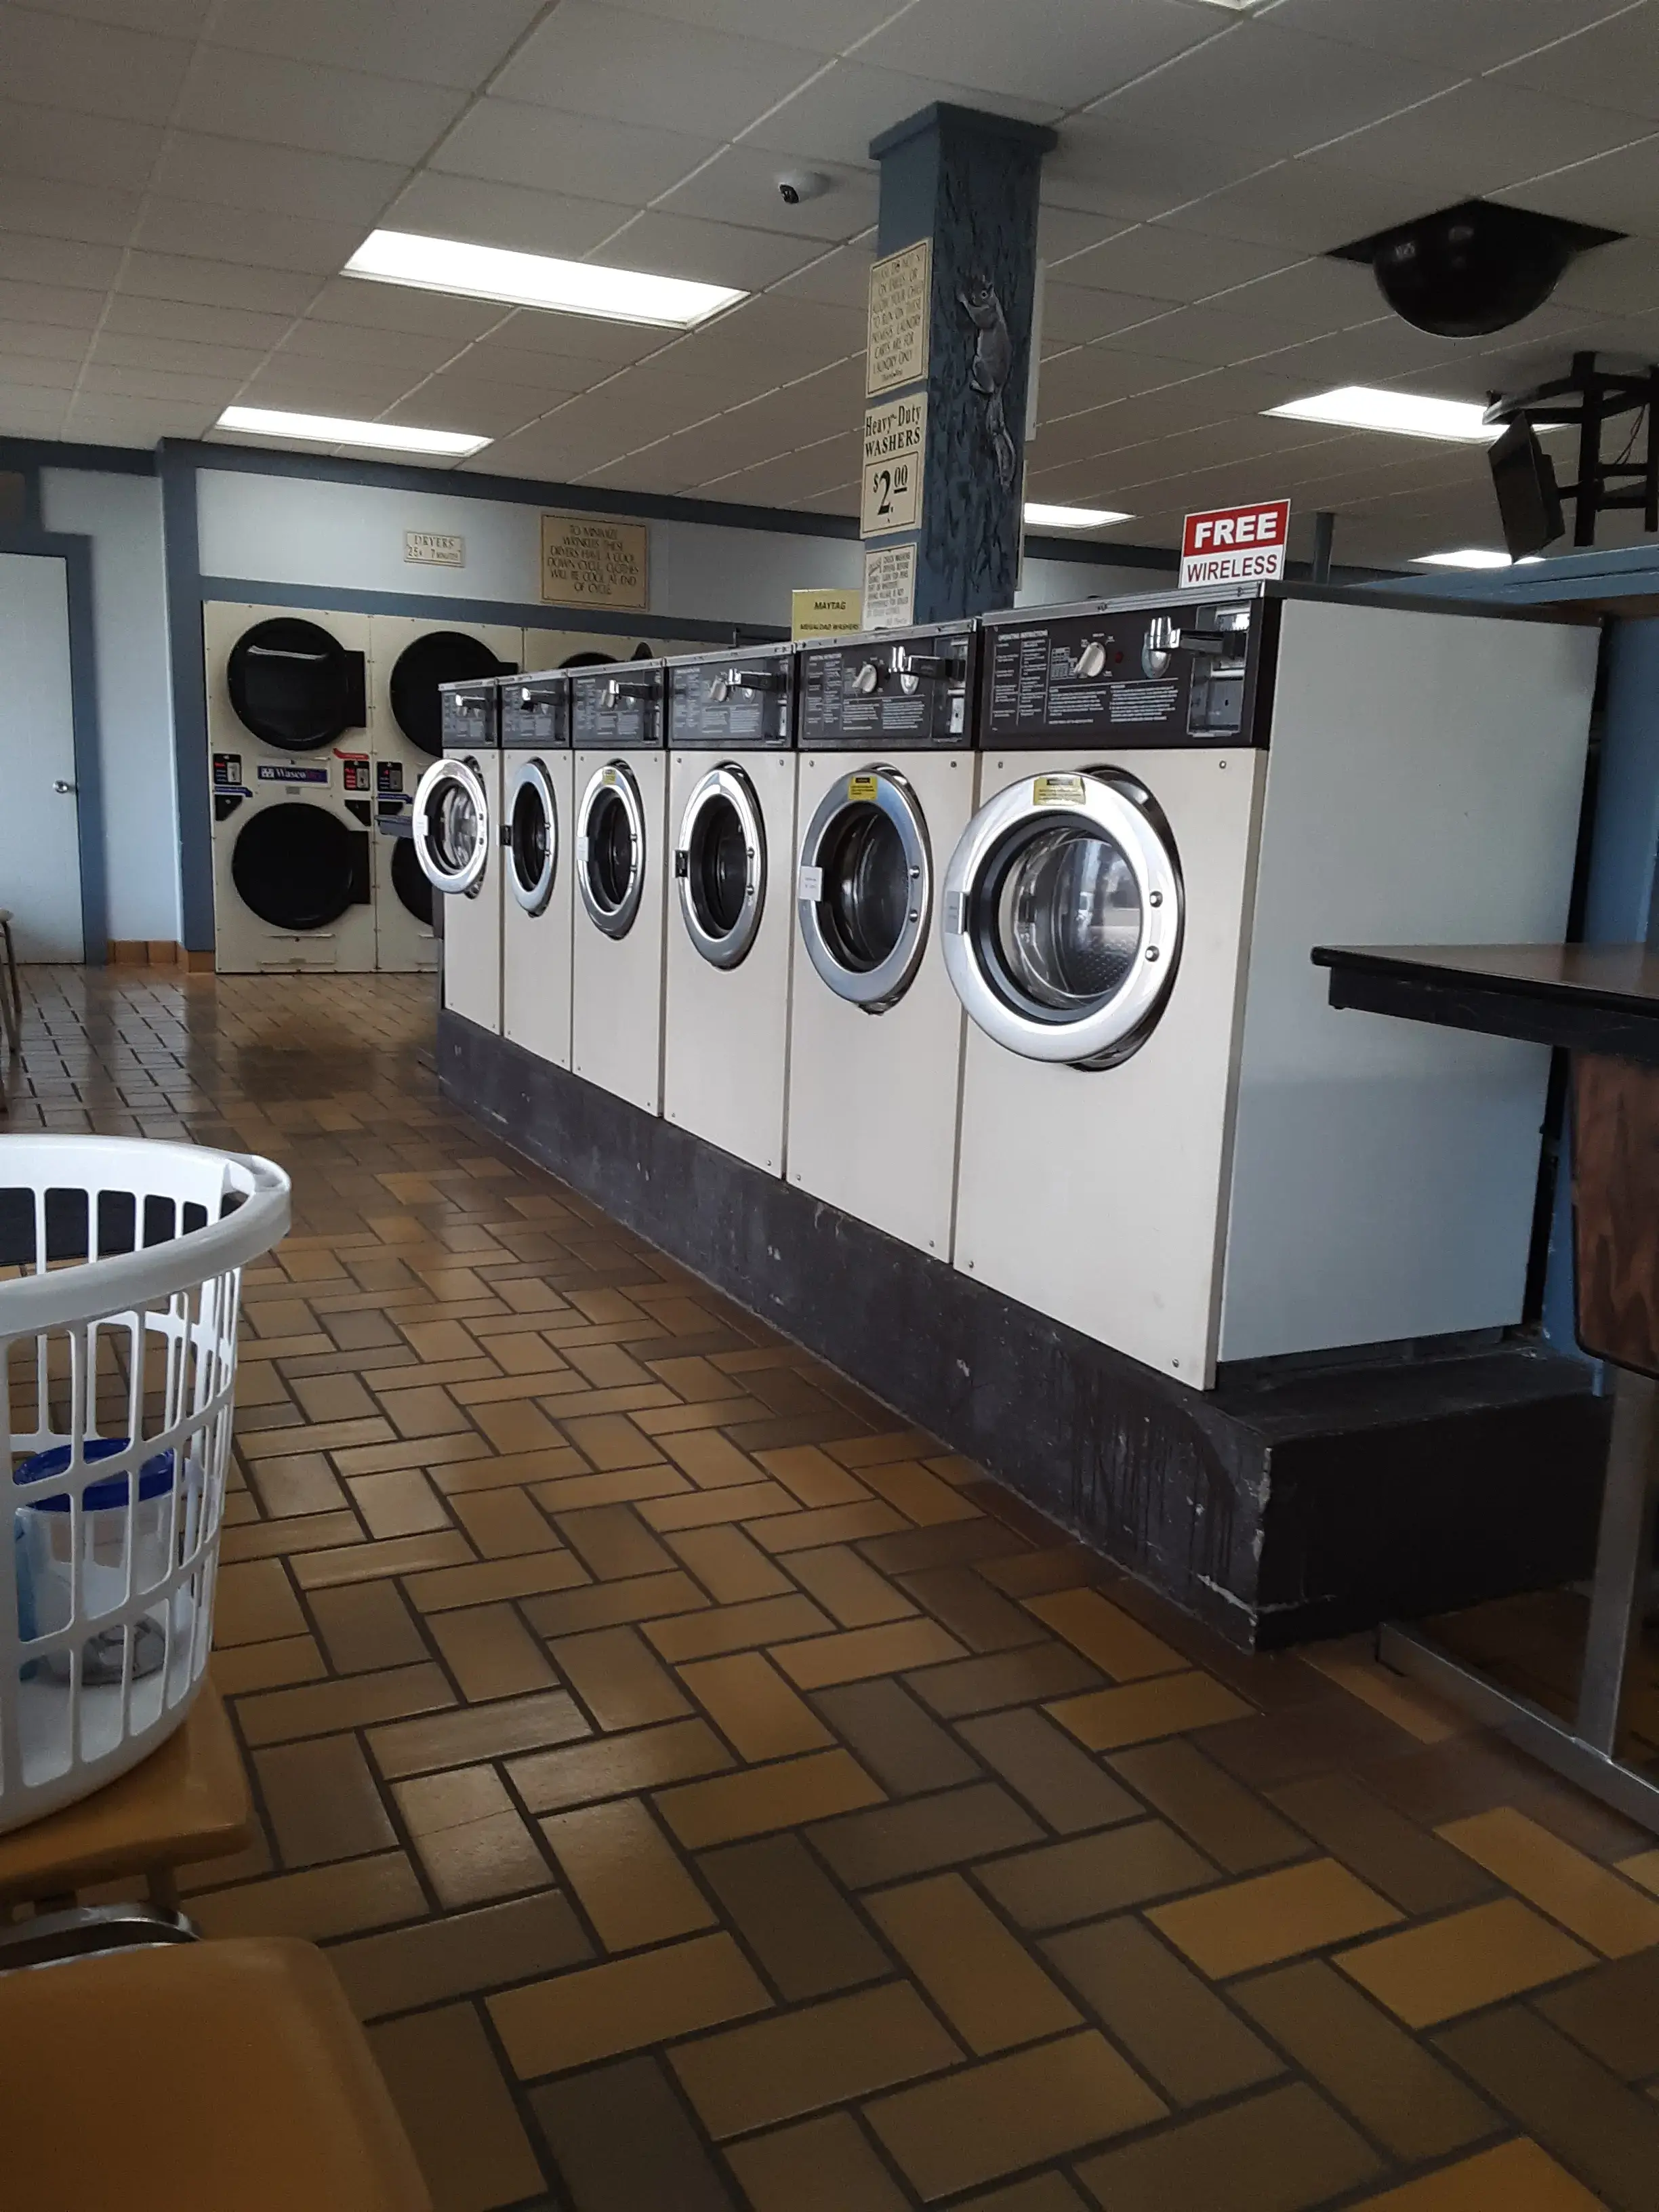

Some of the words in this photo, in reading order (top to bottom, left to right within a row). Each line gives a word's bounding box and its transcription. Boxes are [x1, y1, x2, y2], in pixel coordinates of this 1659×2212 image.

[909, 268, 918, 282] OR
[903, 331, 914, 347] FOR
[873, 354, 897, 375] LAUNDRY
[865, 426, 920, 458] WASHERS
[1194, 512, 1278, 548] FREE
[415, 535, 455, 549] DRYERS
[550, 546, 579, 558] DRYERS
[548, 557, 575, 569] DOWN
[1187, 554, 1277, 582] WIRELESS
[583, 571, 604, 583] COOL
[621, 575, 636, 586] END
[574, 581, 584, 592] OF
[814, 601, 846, 610] MAYTAG
